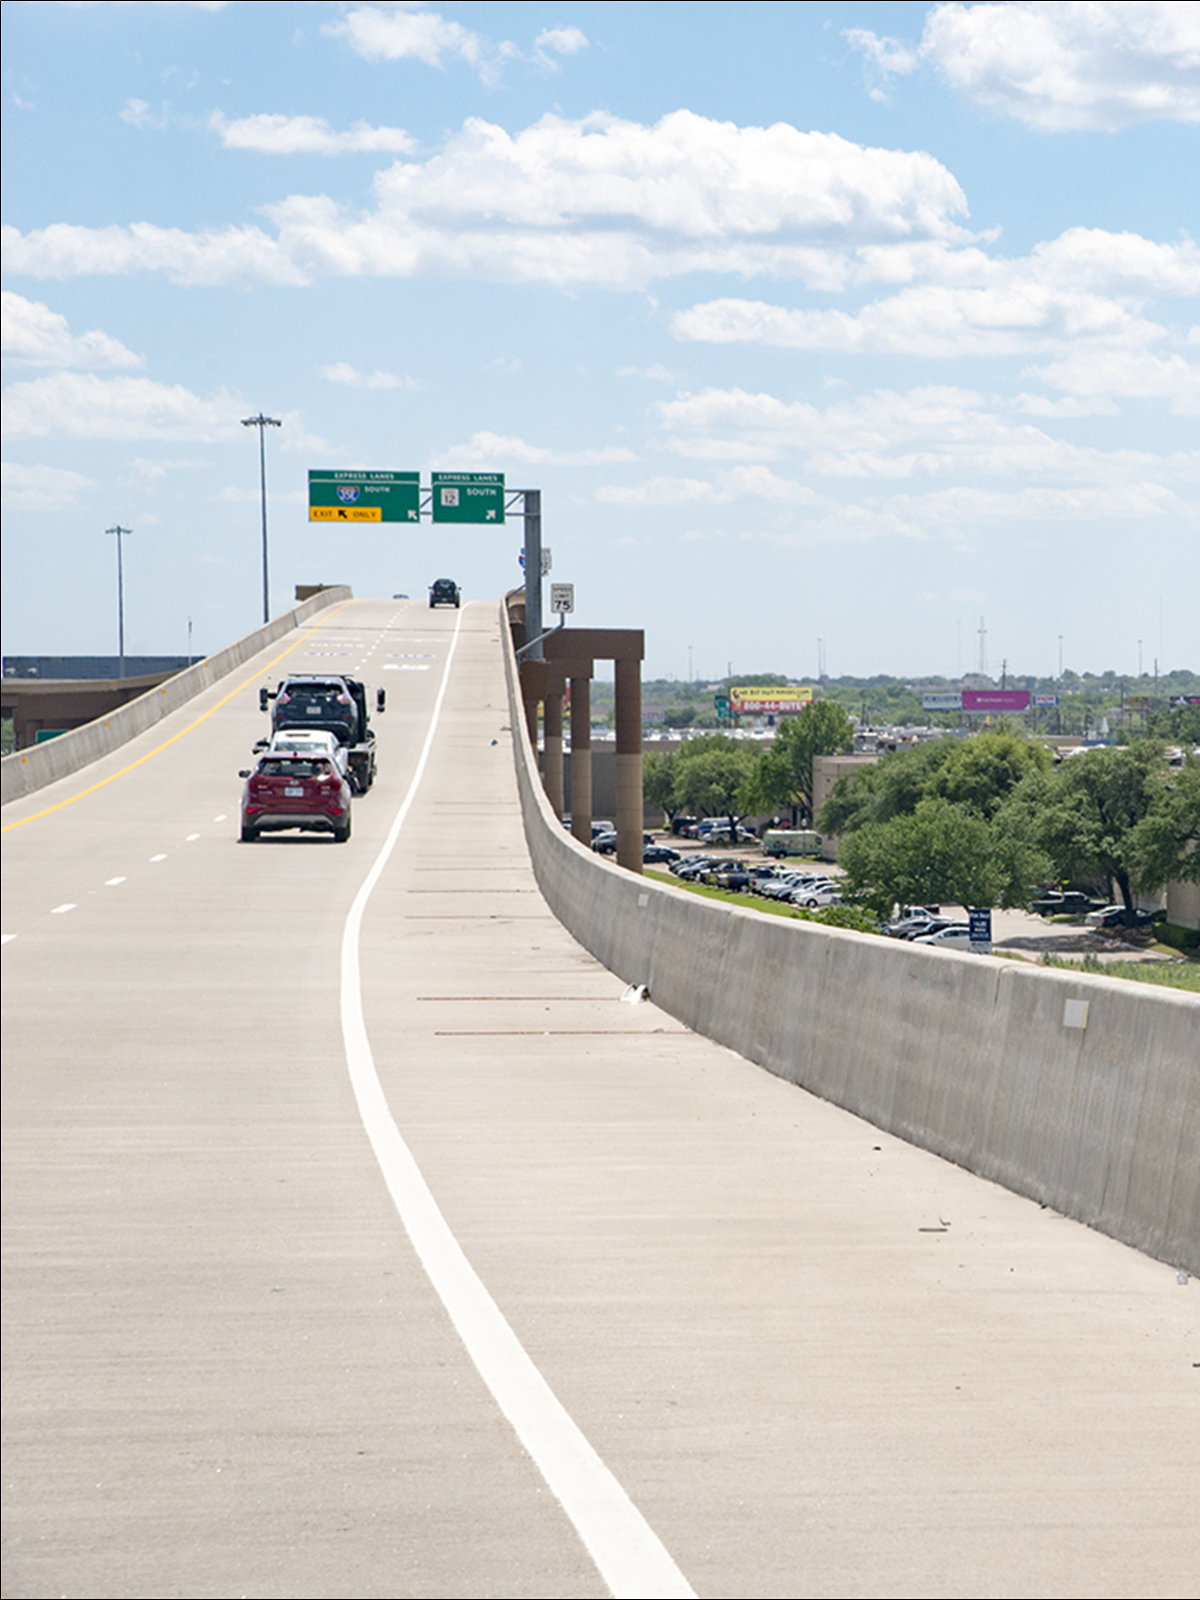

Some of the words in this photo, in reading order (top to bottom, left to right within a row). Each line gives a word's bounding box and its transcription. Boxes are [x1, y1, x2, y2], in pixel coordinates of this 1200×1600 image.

[466, 488, 497, 496] SOUTH
[444, 494, 456, 504] 12
[313, 510, 333, 518] EXIT
[554, 600, 571, 611] 75
